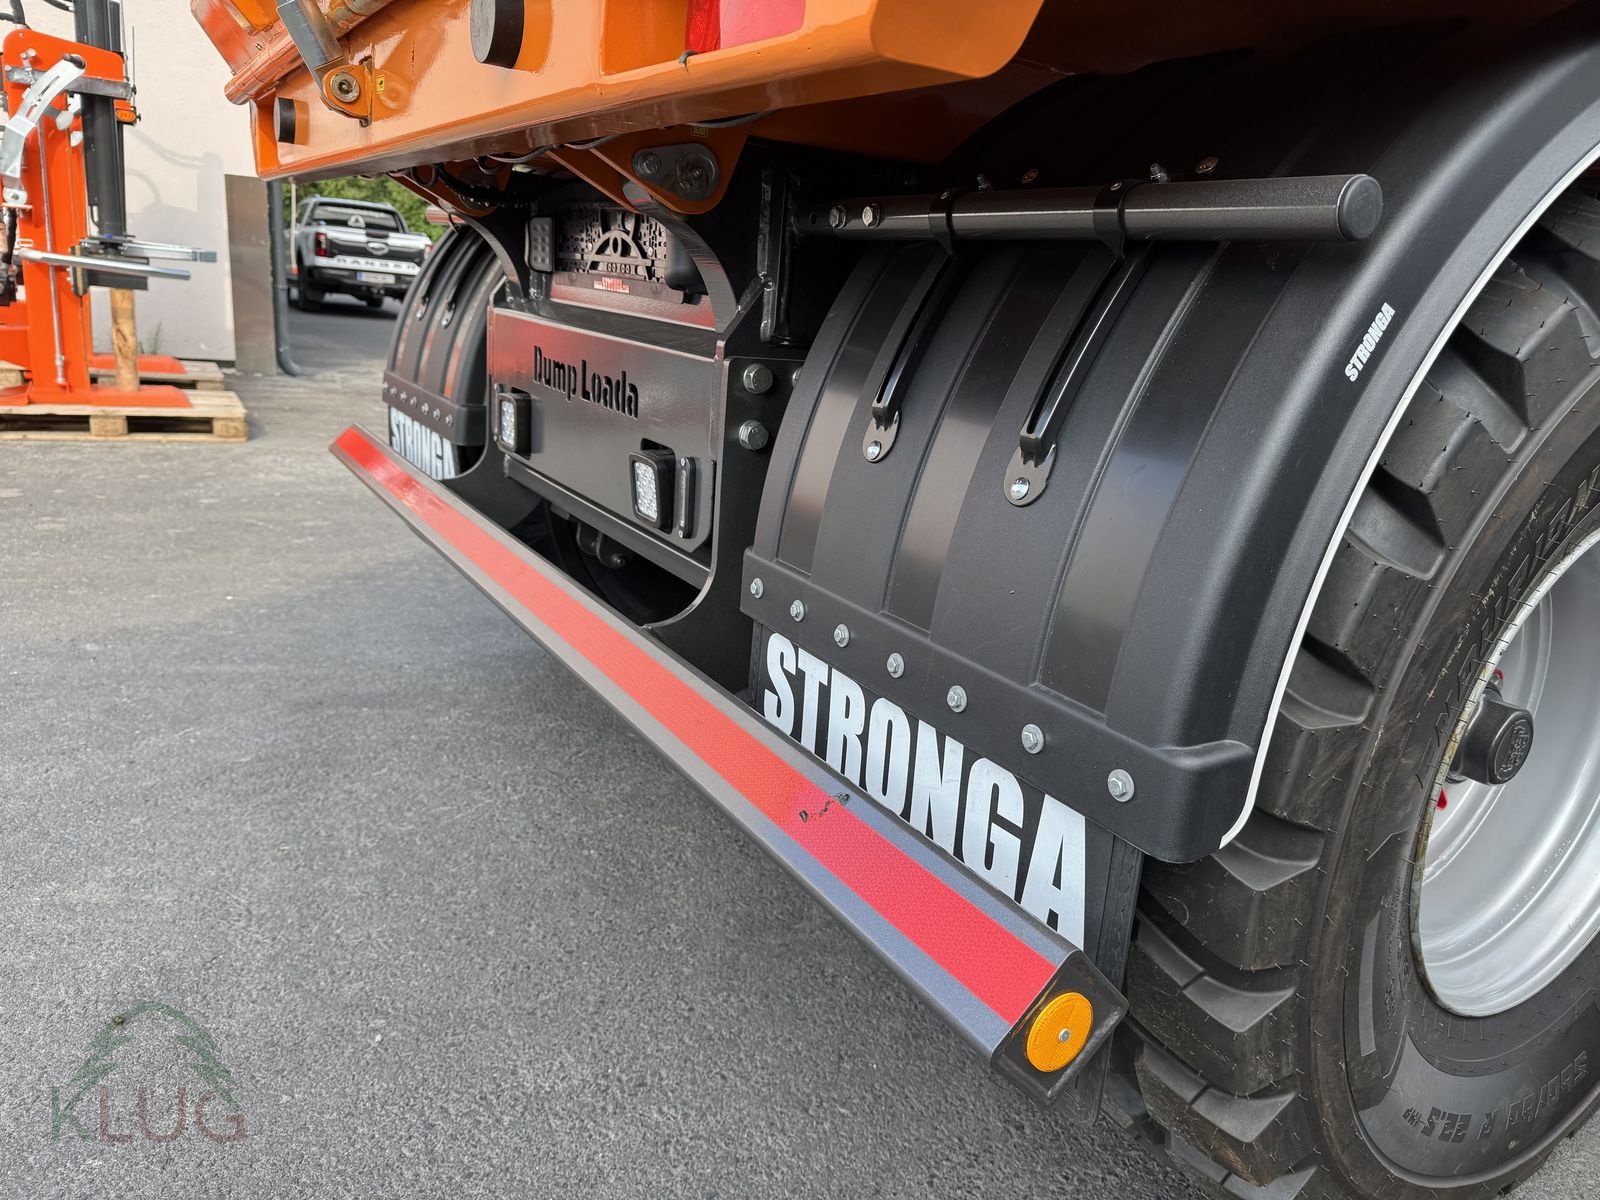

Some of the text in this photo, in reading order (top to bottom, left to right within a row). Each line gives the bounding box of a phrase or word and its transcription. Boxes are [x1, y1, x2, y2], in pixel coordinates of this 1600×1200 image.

[1344, 302, 1396, 382] STRONGA
[533, 345, 639, 420] Dump Loada
[390, 406, 456, 481] STRONGA
[764, 632, 1086, 951] STRONGA
[1420, 1106, 1473, 1144] 22.5
